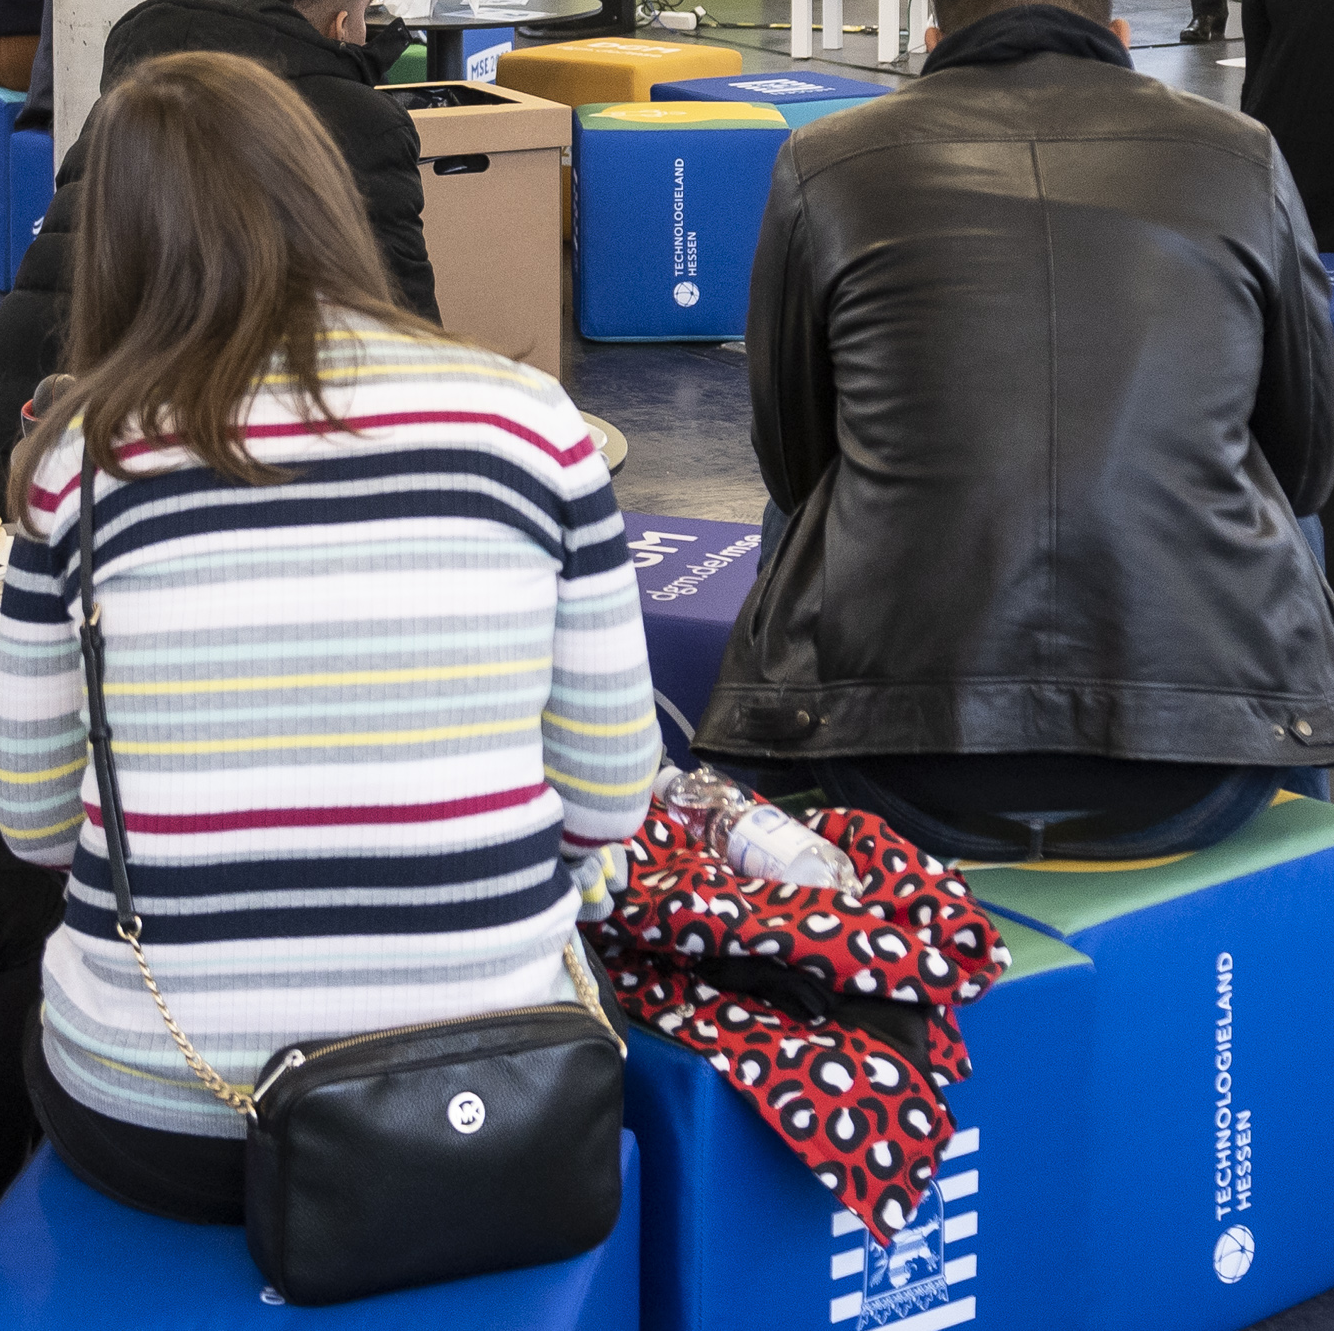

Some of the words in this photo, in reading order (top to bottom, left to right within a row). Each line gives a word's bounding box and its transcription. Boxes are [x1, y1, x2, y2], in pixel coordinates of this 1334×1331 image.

[470, 60, 490, 82] MSE
[674, 157, 685, 277] TECHNOLOGIELAND
[686, 231, 698, 277] HESSEN
[627, 531, 699, 568] GM
[646, 534, 762, 601] dgm.de/mse
[1215, 951, 1233, 1221] TECHNOLOGIELAND
[1235, 1109, 1252, 1212] HESSEN
